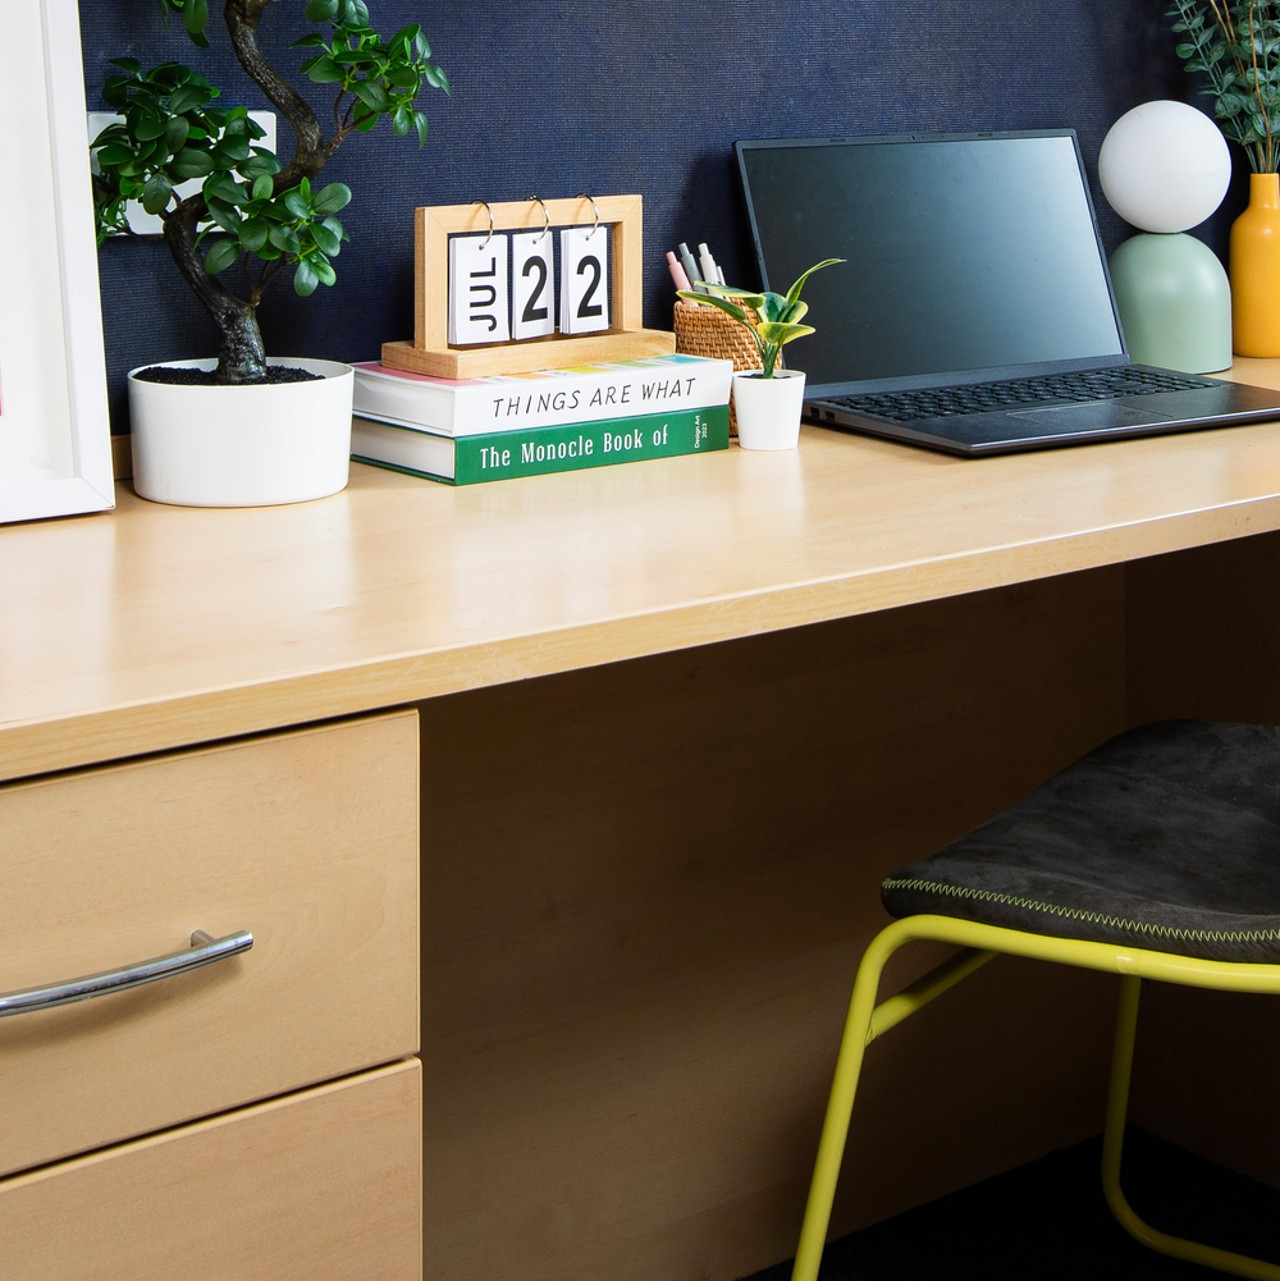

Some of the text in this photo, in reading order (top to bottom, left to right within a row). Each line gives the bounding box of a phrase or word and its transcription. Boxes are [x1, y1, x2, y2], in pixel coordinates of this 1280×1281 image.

[469, 255, 603, 332] JUL 2 2
[493, 377, 697, 418] THINGS ARE WHAT
[480, 423, 668, 469] The Monocle Book of
